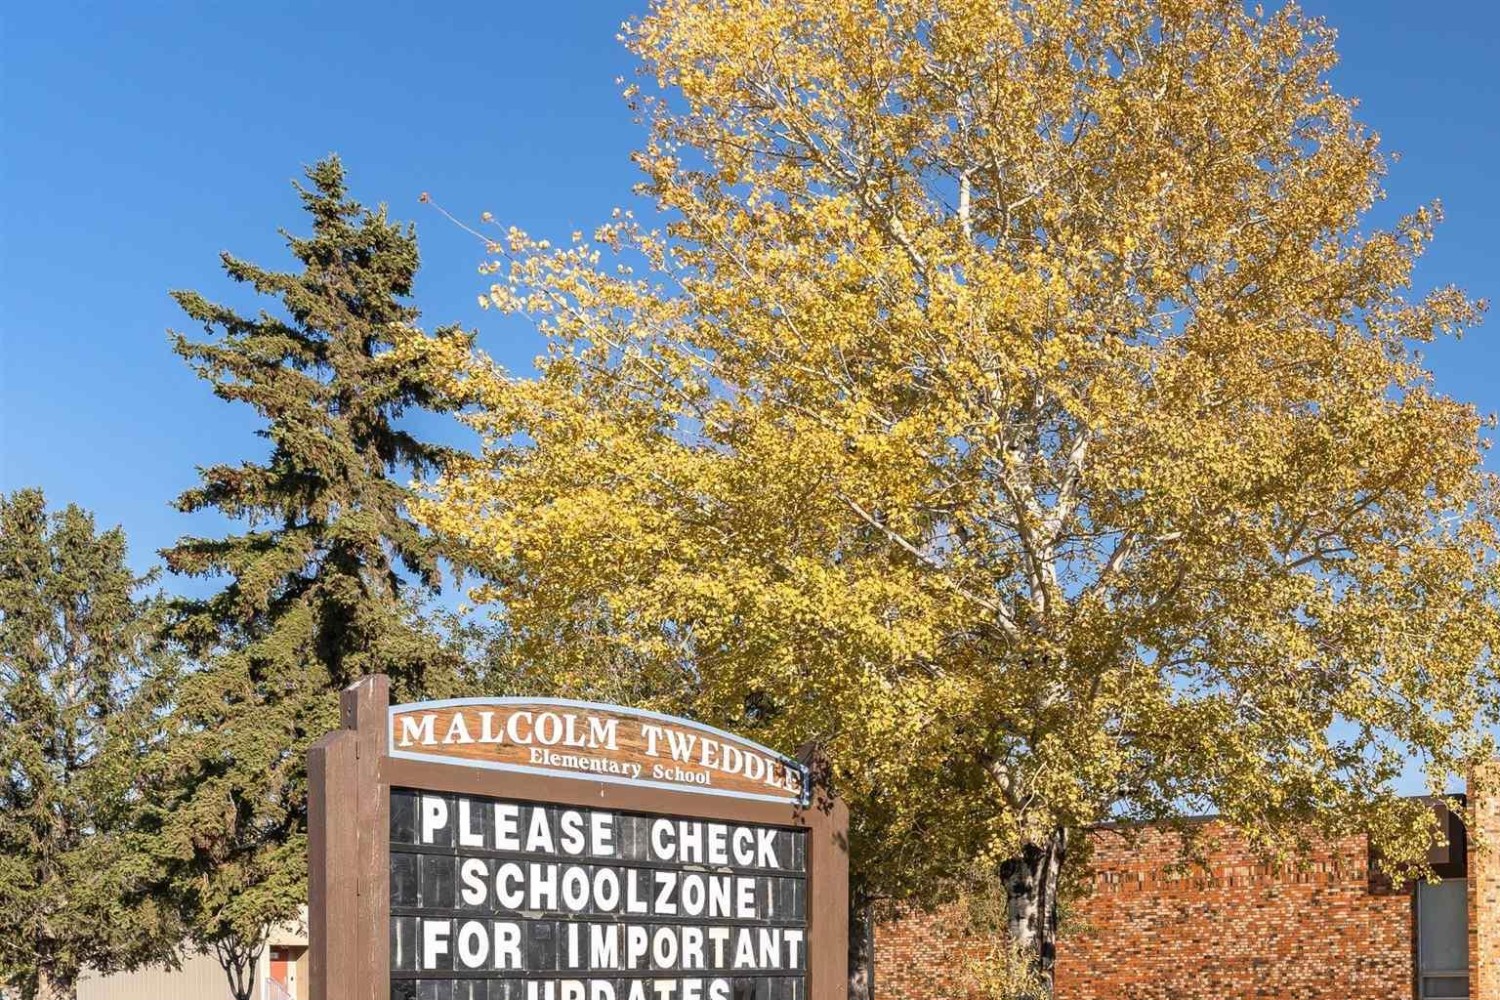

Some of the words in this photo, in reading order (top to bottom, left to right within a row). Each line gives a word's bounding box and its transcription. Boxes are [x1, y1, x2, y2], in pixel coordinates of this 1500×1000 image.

[399, 711, 619, 750] MALCOLM
[641, 724, 801, 795] TWEDDLE
[529, 747, 642, 779] Elementary
[652, 764, 711, 786] School
[422, 794, 615, 856] PLEASE
[652, 818, 779, 869] CHECK
[461, 858, 756, 919] SCHOOLZONE
[423, 920, 522, 970] FOR
[568, 923, 804, 971] IMPORTANT
